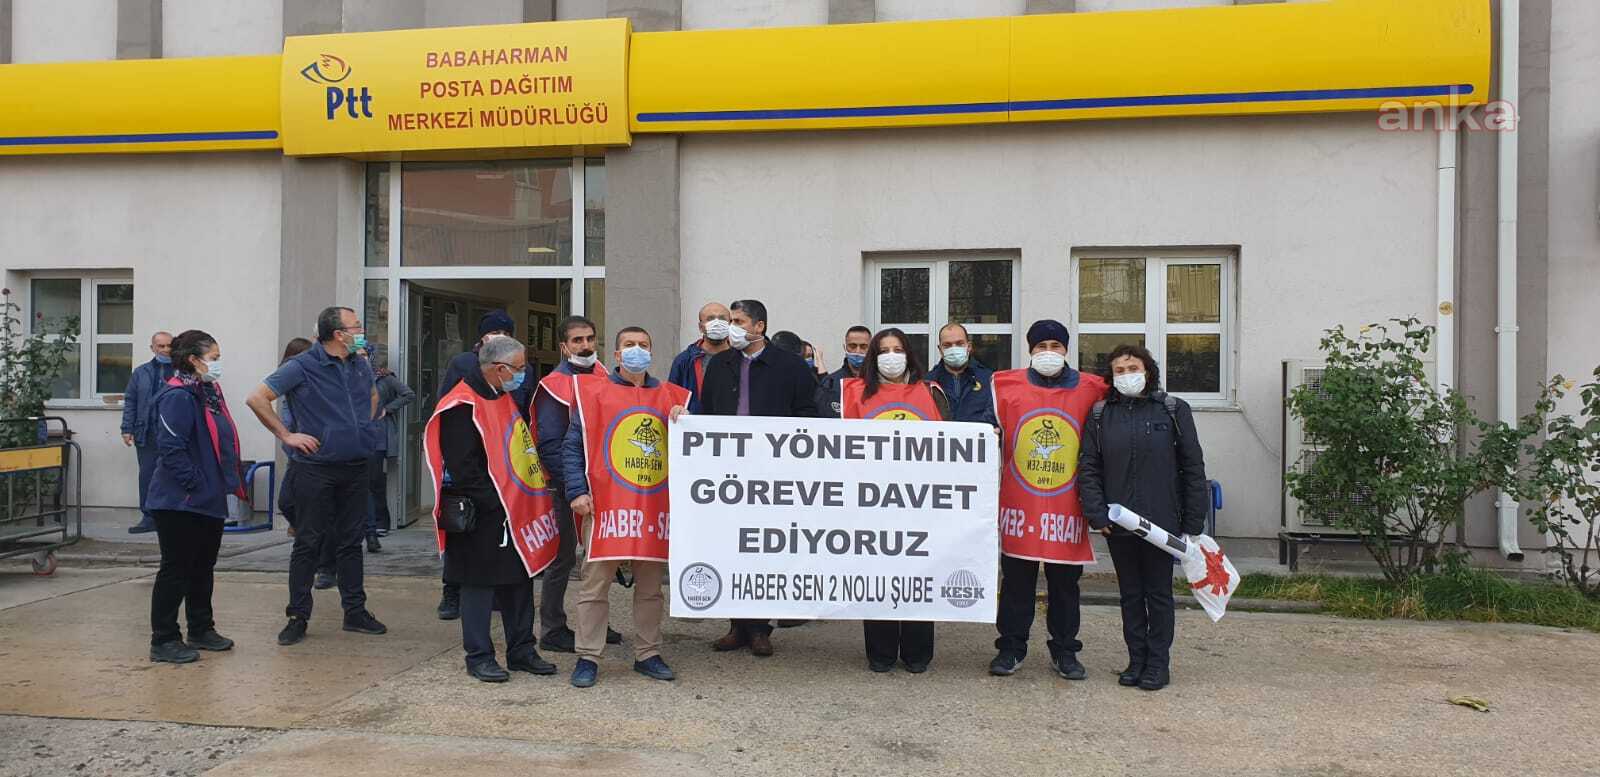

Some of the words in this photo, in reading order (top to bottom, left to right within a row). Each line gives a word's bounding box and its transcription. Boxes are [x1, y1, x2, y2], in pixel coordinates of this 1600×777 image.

[426, 45, 568, 69] BABAHARMAN
[420, 79, 484, 99] POSTA
[491, 73, 573, 96] DAĞITIM
[326, 86, 373, 120] Ptt
[388, 107, 473, 131] MERKEZİ
[480, 102, 608, 128] MÜDÜRLÜĞÜ
[682, 431, 753, 458] PTT
[765, 428, 986, 463] YÖNETİMİNİ
[690, 473, 844, 507] GÖREVE
[857, 482, 978, 510] DAVET
[598, 508, 645, 539] HABER
[738, 522, 929, 557] EDİYORUZ
[731, 573, 787, 601] HABER
[792, 573, 824, 601] SEN
[828, 575, 837, 601] 2
[842, 575, 886, 602] NOLU
[890, 576, 934, 609] ŞUBE
[940, 586, 985, 600] KESK
